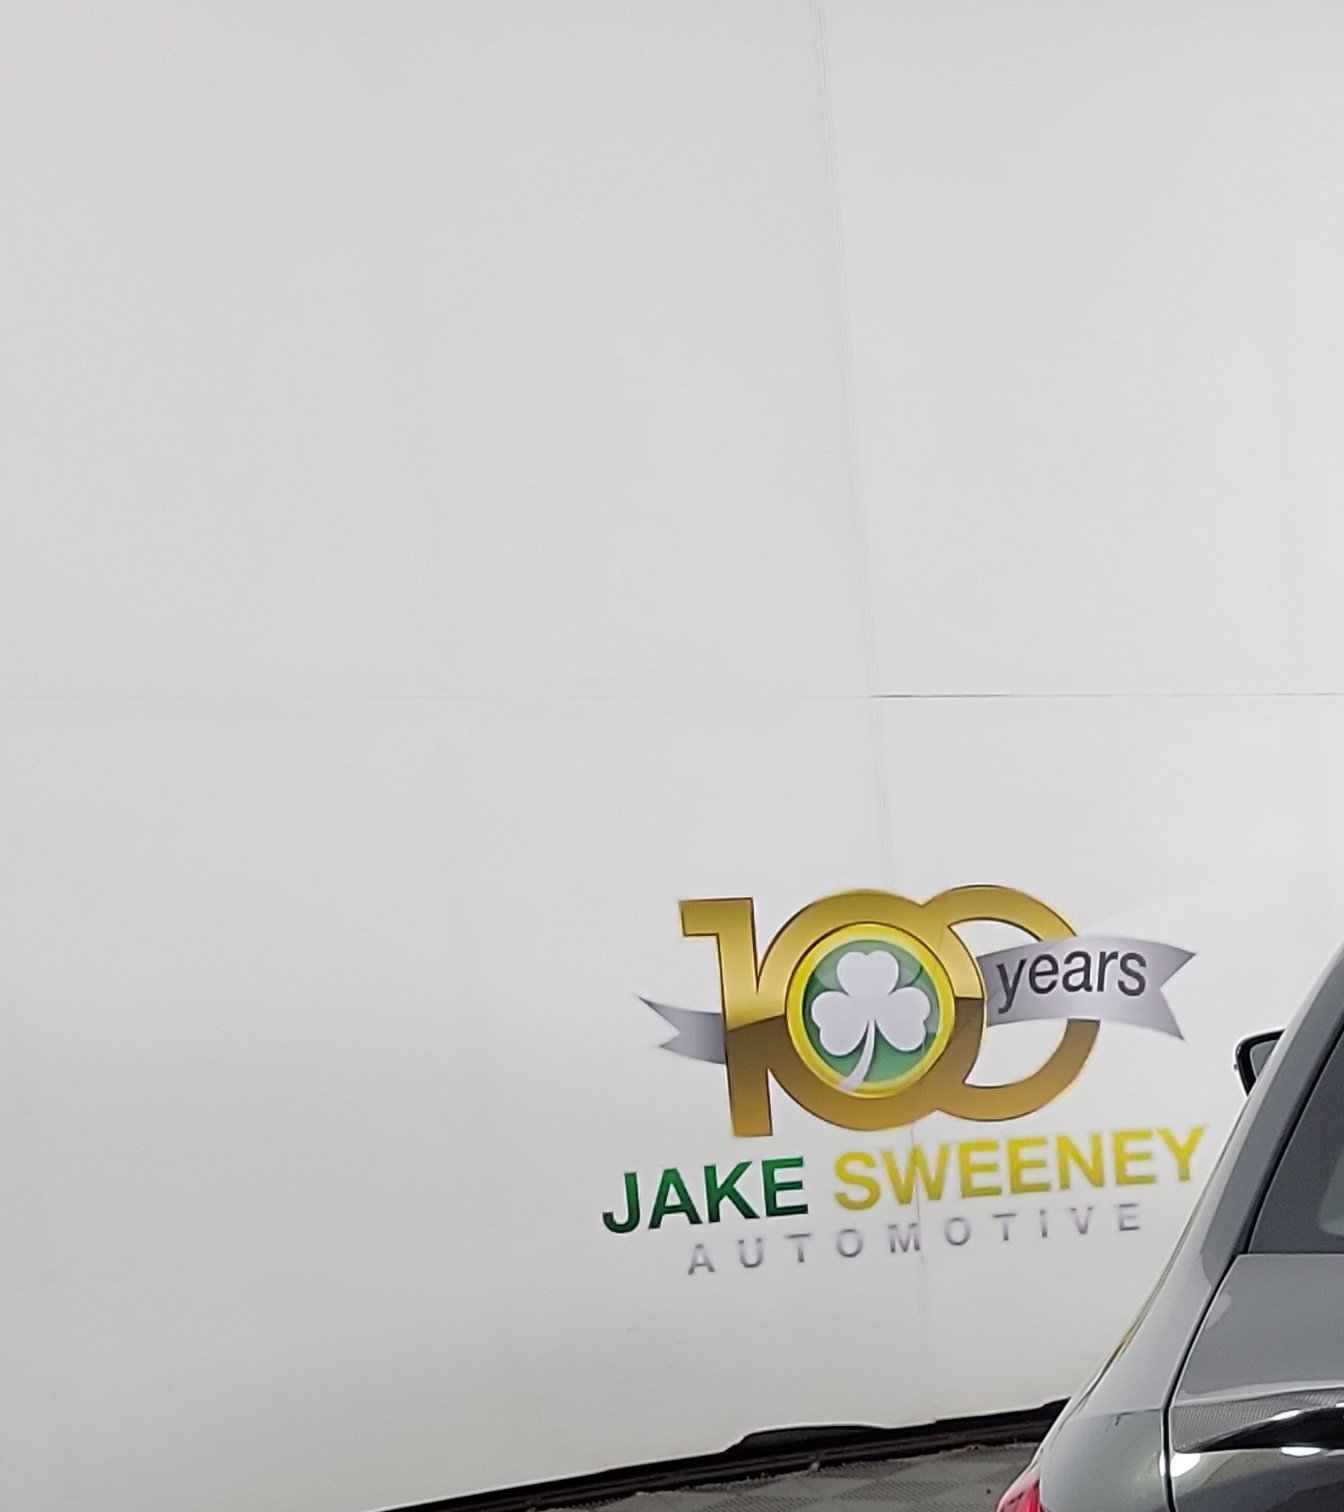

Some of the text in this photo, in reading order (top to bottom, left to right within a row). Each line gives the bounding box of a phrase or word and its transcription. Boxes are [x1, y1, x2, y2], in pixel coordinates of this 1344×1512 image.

[679, 884, 1100, 1138] 100
[997, 949, 1147, 1014] years
[602, 1126, 1207, 1233] JAKE SWEENEY
[687, 1203, 1141, 1275] AUTOMOTIVE
